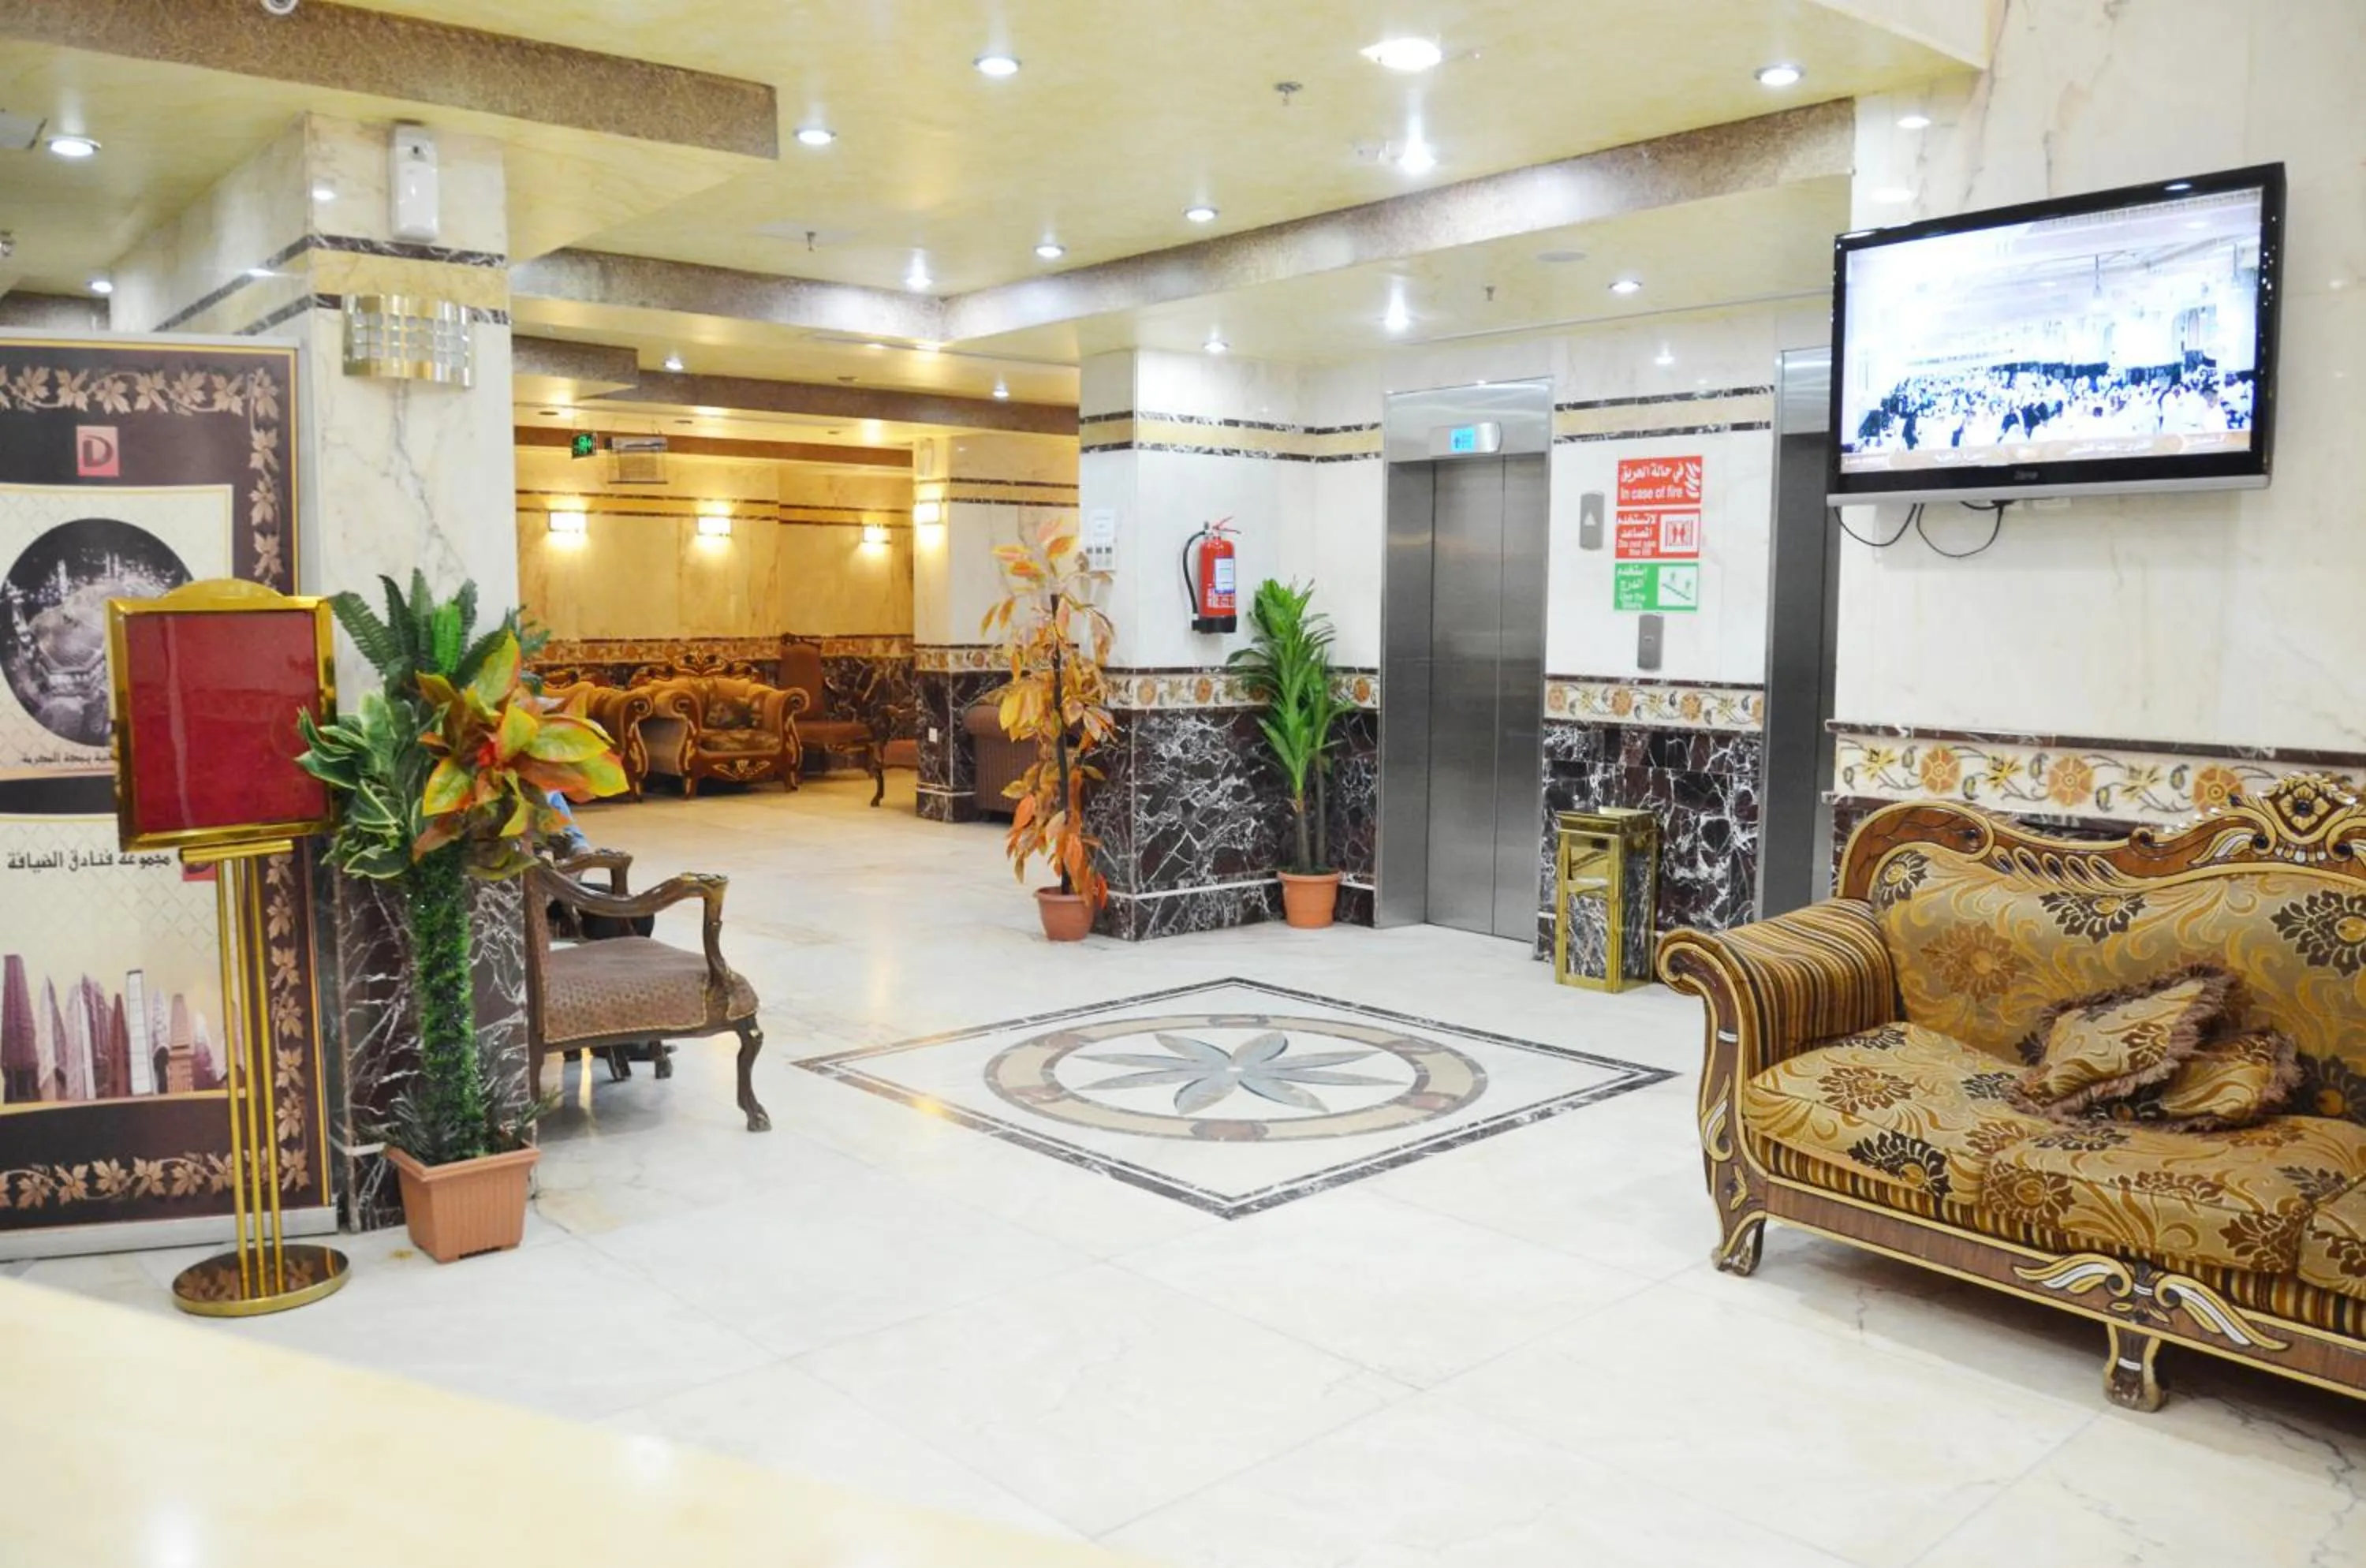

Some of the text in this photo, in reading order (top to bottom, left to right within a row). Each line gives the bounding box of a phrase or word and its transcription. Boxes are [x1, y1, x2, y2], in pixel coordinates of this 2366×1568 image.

[82, 434, 114, 468] D
[1621, 461, 1684, 483] في حالة الحريق
[1621, 484, 1683, 500] In case of fire
[7, 850, 63, 874] الضيافة
[68, 849, 114, 872] فنادق
